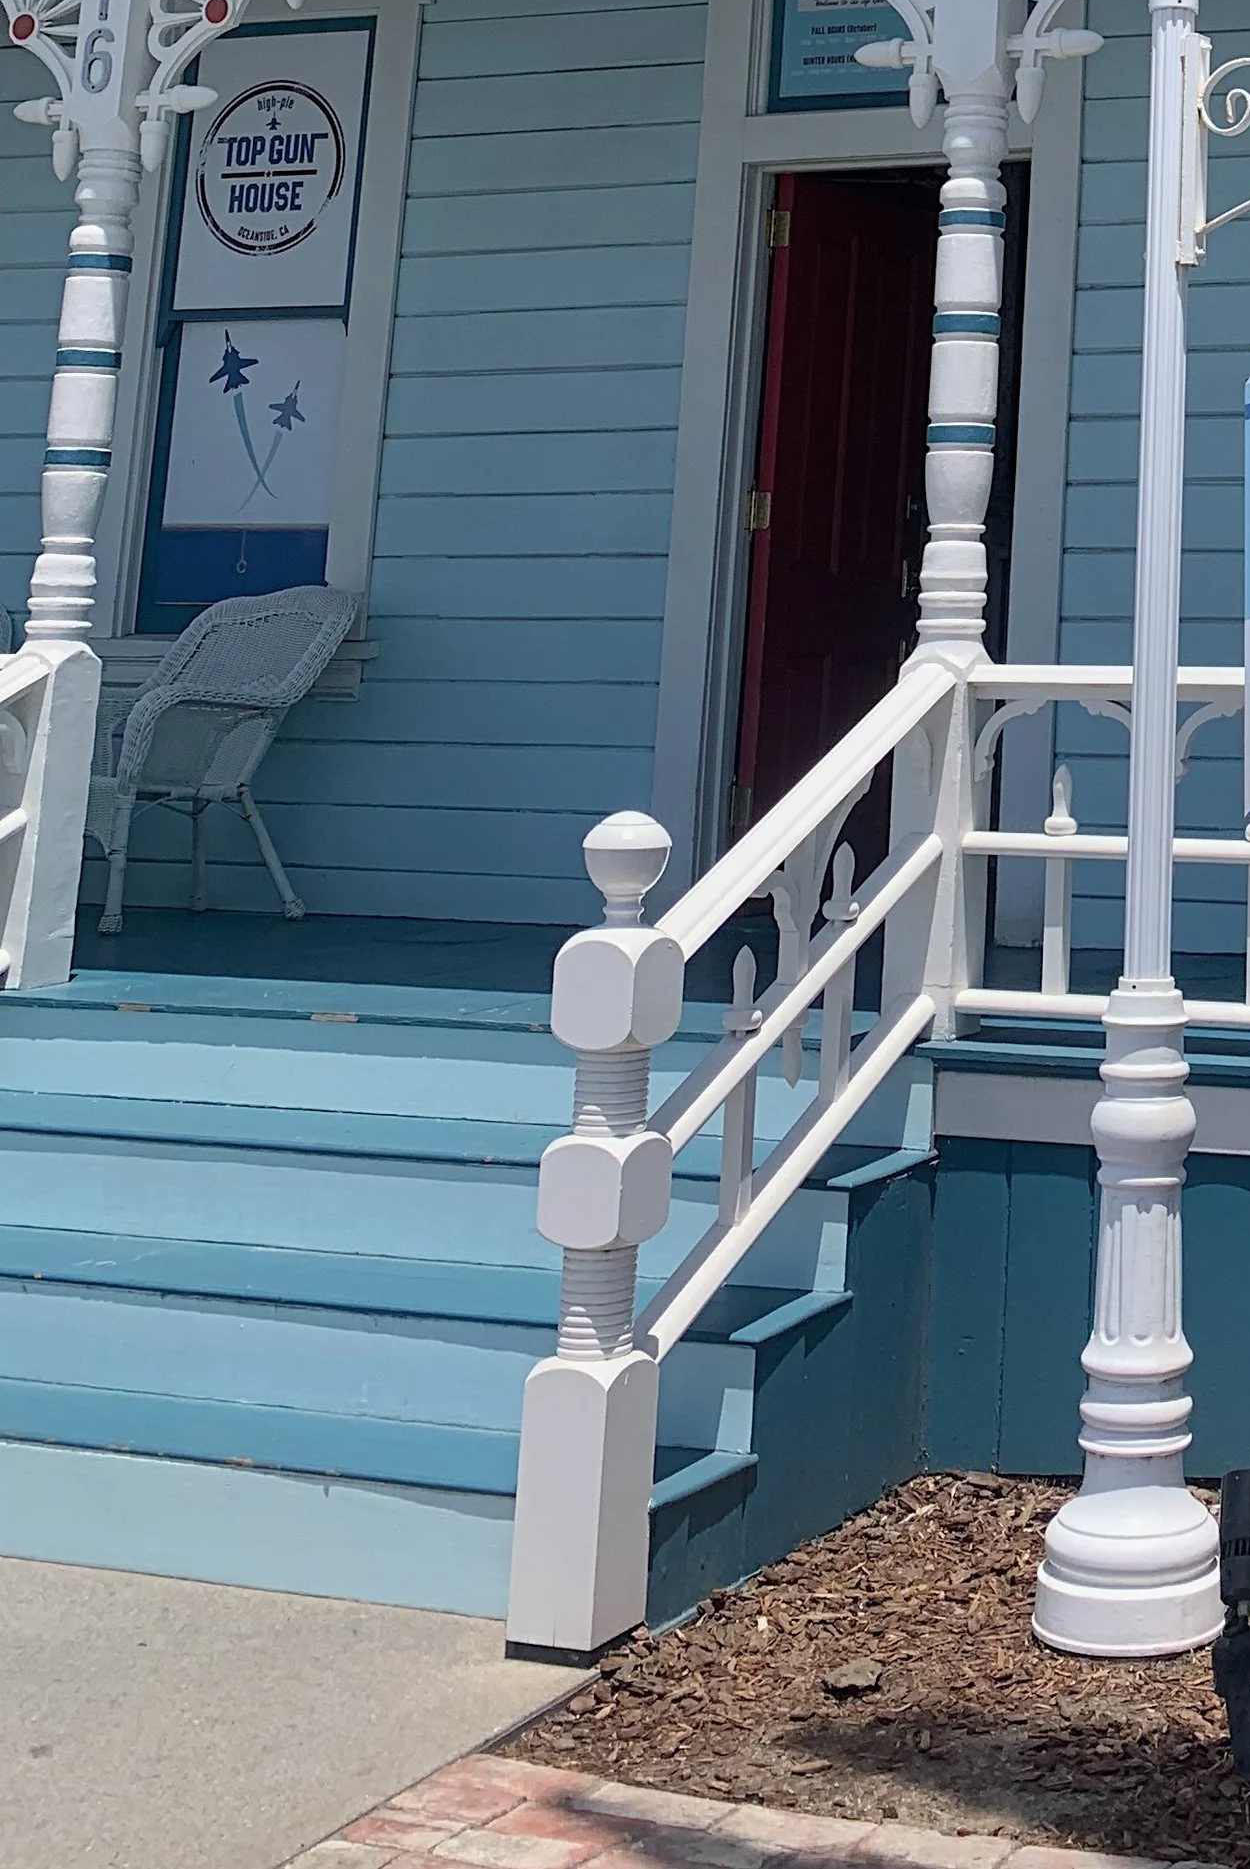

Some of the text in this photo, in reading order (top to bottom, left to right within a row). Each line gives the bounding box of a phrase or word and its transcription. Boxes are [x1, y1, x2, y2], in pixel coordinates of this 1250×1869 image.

[218, 132, 329, 167] TOP GUN
[228, 181, 304, 214] HOUSE
[279, 224, 290, 237] CA
